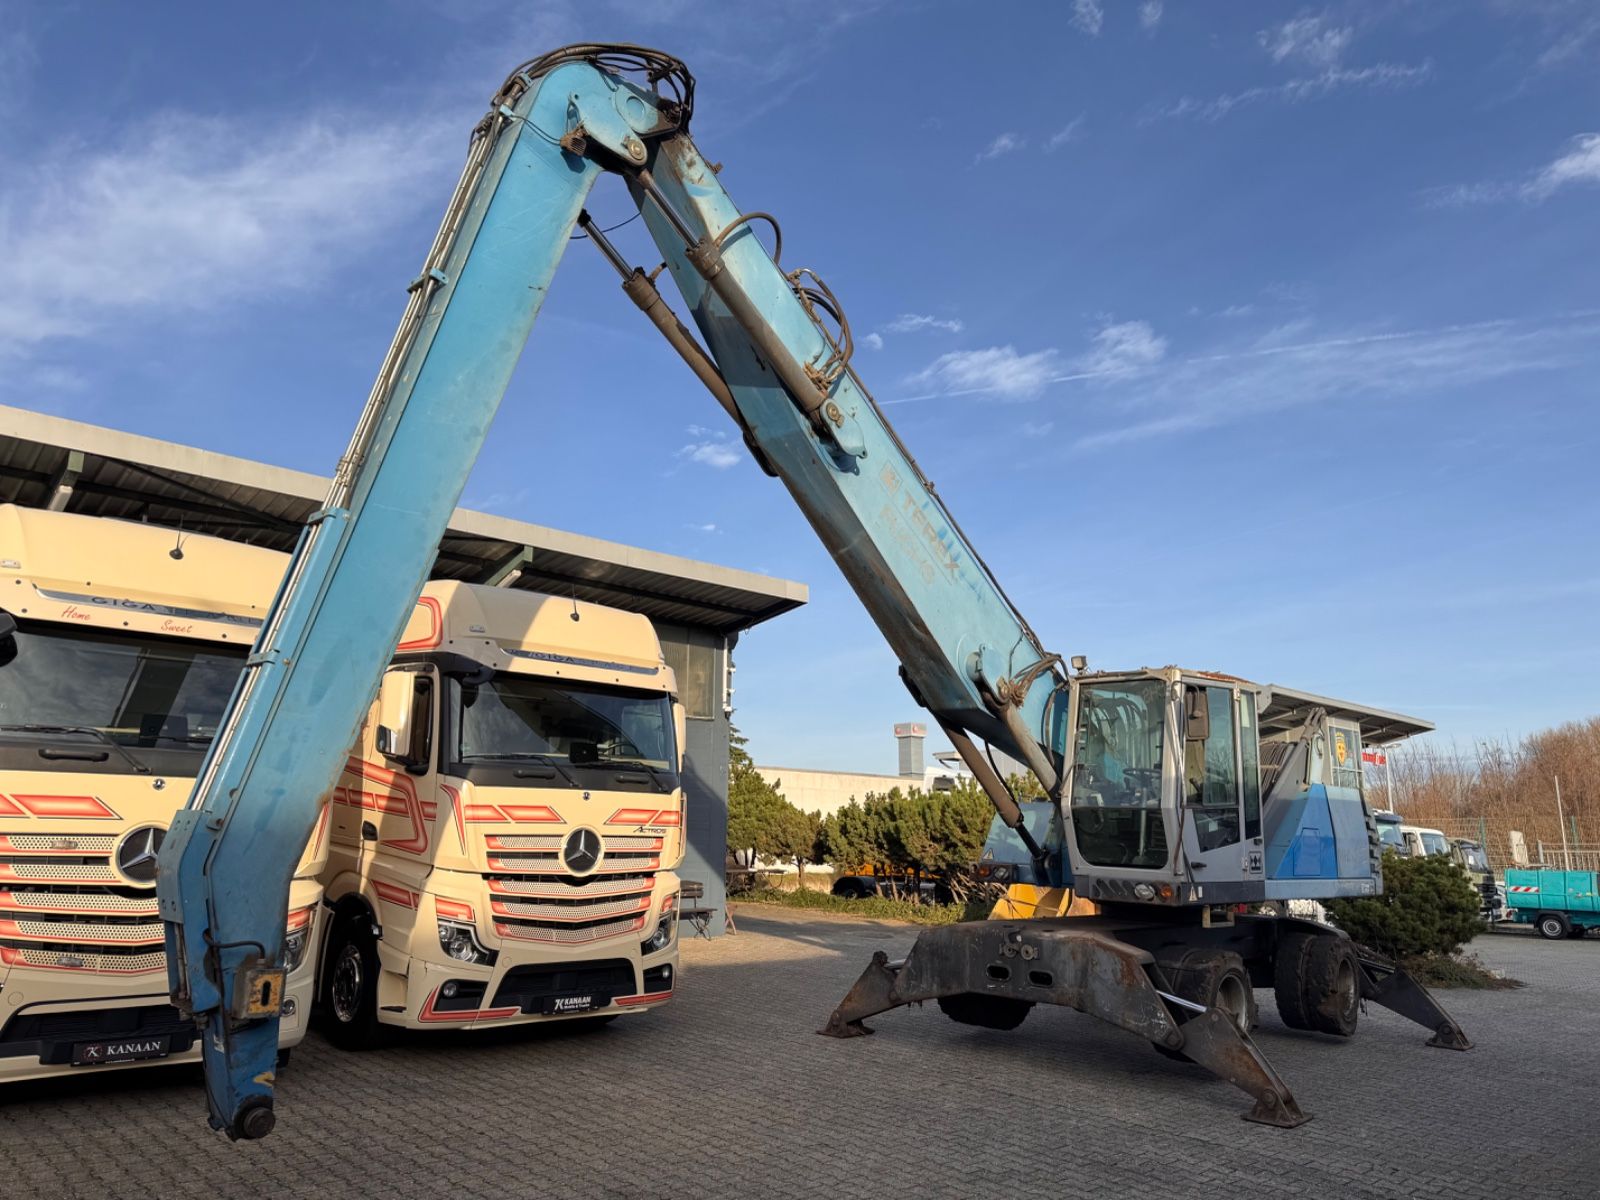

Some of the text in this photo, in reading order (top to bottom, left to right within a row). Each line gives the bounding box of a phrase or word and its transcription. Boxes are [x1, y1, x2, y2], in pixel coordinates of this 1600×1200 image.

[91, 596, 156, 611] GIGA
[61, 605, 91, 621] Home
[161, 619, 193, 634] Sweet
[107, 1041, 161, 1055] KANAAN
